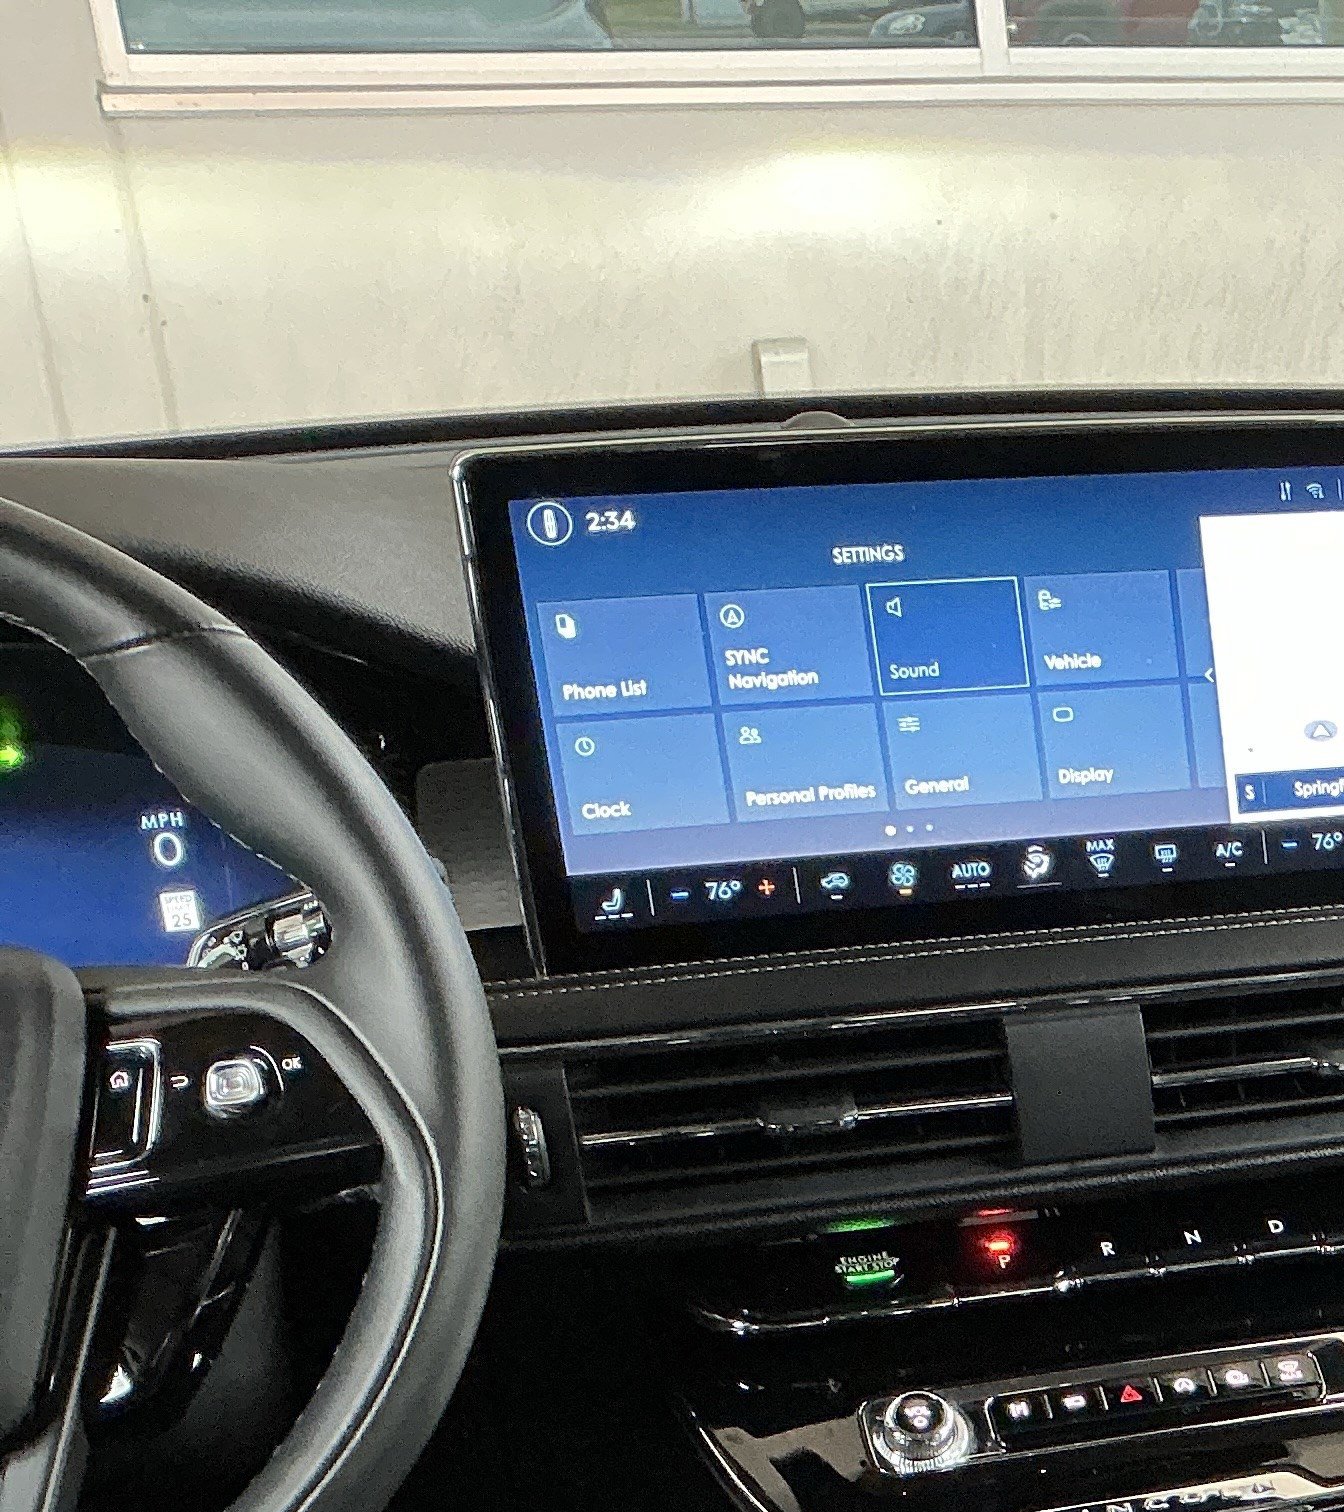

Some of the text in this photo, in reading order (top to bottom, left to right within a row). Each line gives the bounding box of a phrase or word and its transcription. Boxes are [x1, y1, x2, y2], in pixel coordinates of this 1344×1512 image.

[585, 510, 637, 531] 2:34
[832, 544, 905, 564] SETTINGS
[725, 648, 770, 667] SYNC
[1043, 653, 1102, 671] Vehicle
[728, 669, 820, 690] Navigation
[889, 661, 940, 679] Sound
[562, 679, 647, 701] Phone List
[904, 776, 970, 795] General
[1058, 767, 1114, 786] Display
[745, 783, 877, 807] Personal Profiles
[1244, 784, 1255, 800] S
[581, 801, 632, 820] Clock
[140, 811, 184, 830] MPH
[153, 832, 183, 867] 0
[1086, 838, 1115, 852] MAX
[1215, 842, 1244, 858] A/C
[951, 861, 992, 879] AUTO
[172, 913, 192, 928] 25
[281, 1057, 301, 1071] OK
[998, 1219, 1284, 1268] P R N D
[839, 1251, 888, 1264] ENGINE
